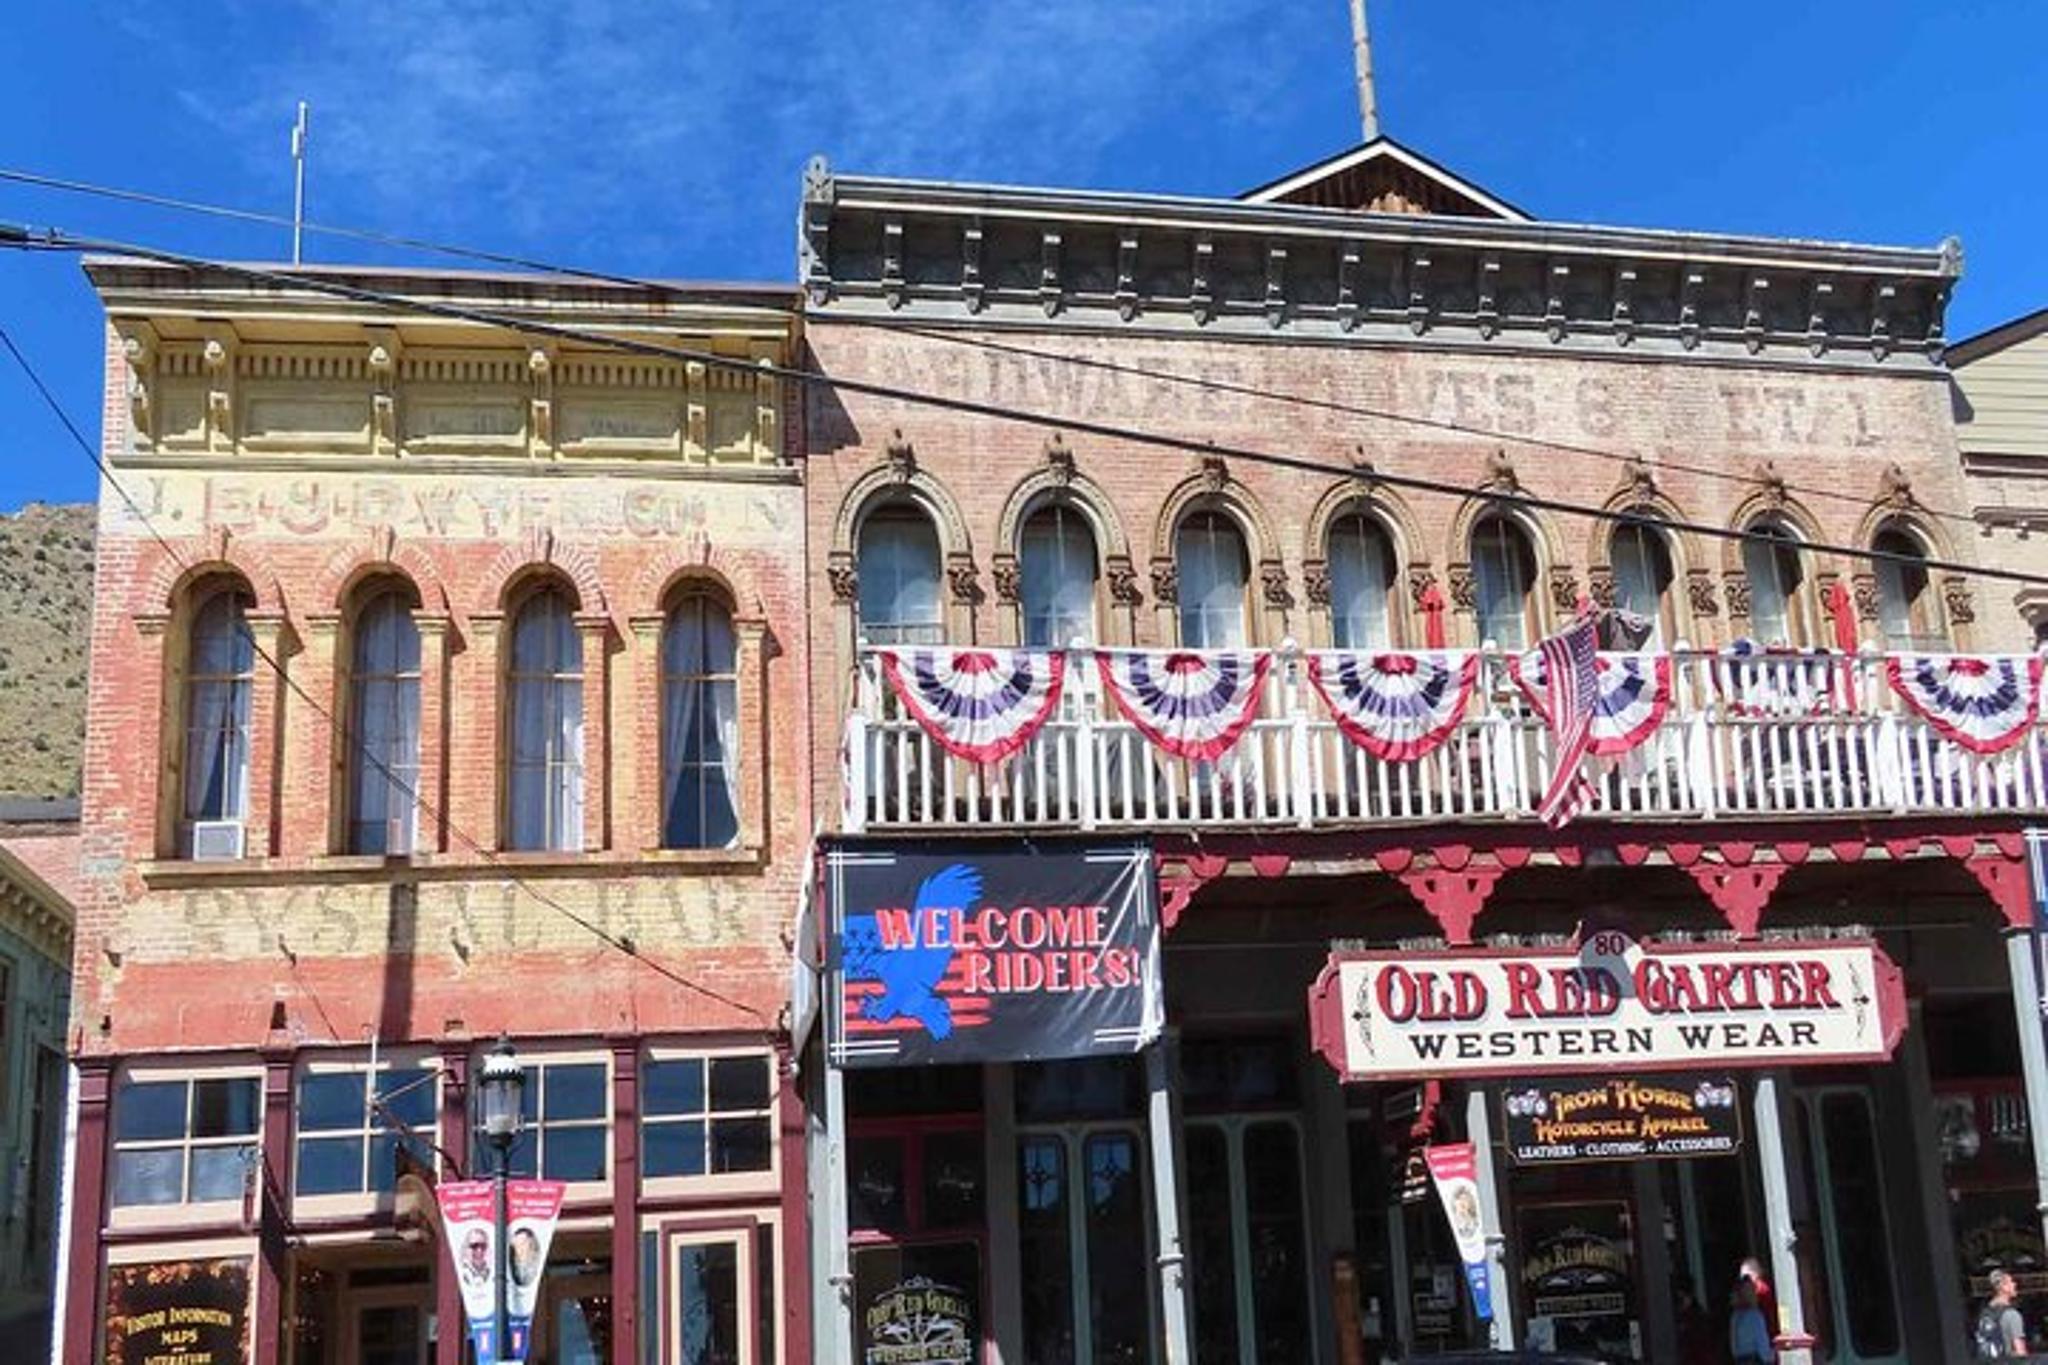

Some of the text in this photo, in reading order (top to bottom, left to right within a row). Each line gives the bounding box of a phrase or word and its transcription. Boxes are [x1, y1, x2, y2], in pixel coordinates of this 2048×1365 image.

[875, 907, 1109, 950] WELCOME
[1595, 935, 1626, 956] 80
[963, 948, 1141, 993] RIDERS!
[1375, 957, 1840, 1024] OLD RED GARTER
[1409, 1022, 1820, 1060] WESTERN WEAR
[1550, 1081, 1693, 1120] IRON HORSE
[1532, 1115, 1710, 1143] MOTORCYCLE APPAREL
[1518, 1137, 1733, 1159] LEATHERS CLOTHING ACCESSORIES
[169, 1307, 232, 1326] INFORMATION
[161, 1329, 198, 1345] MAPS
